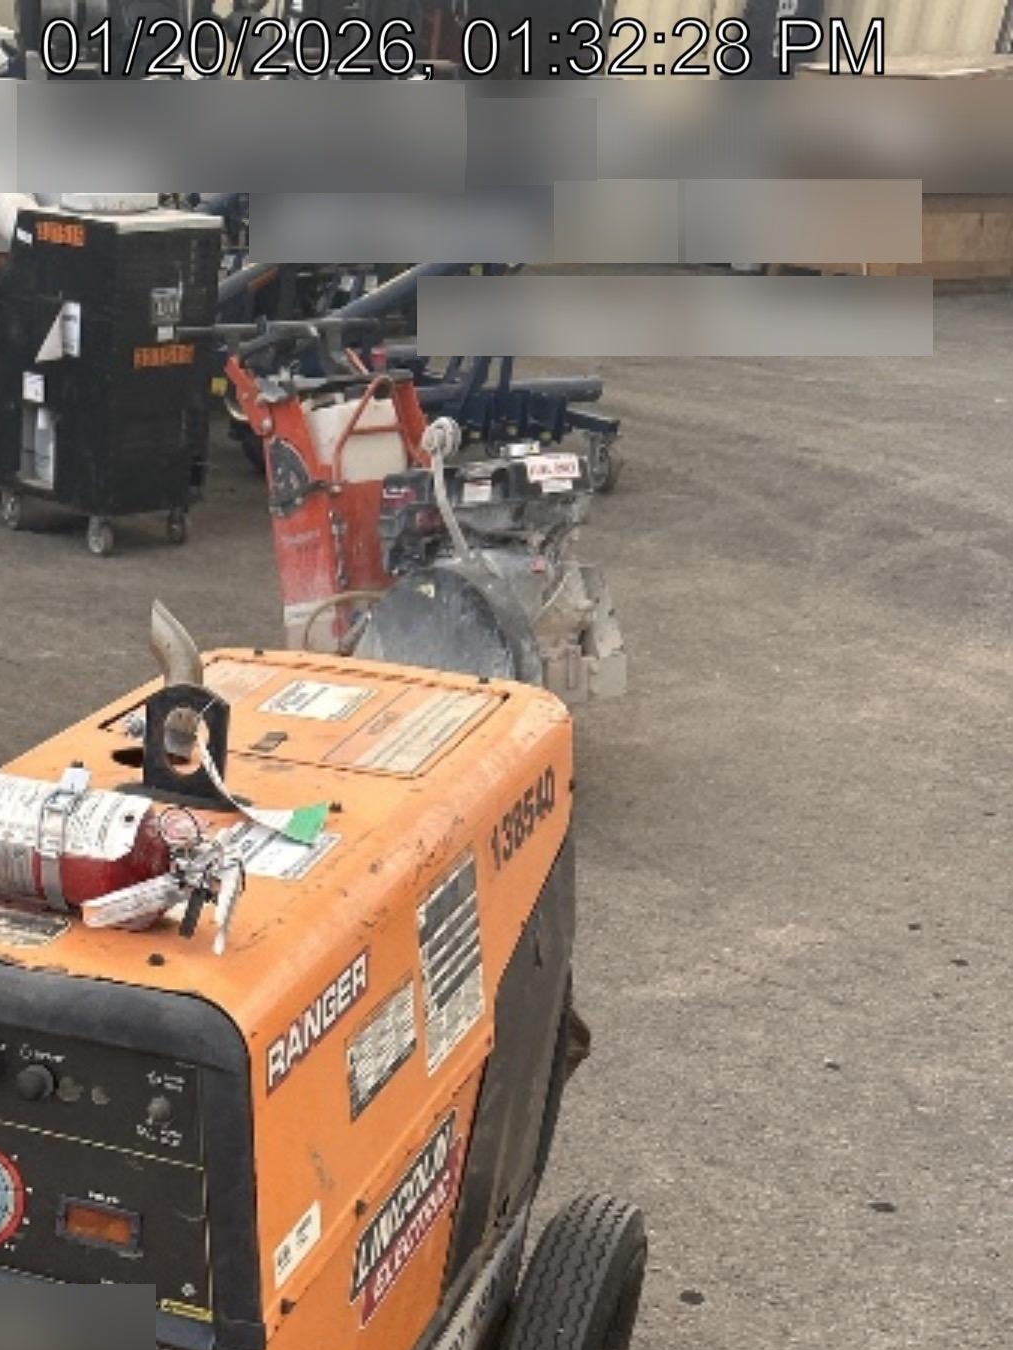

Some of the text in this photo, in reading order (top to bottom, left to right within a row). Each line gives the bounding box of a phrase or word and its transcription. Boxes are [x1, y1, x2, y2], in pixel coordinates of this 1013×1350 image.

[490, 765, 556, 871] 138540
[267, 950, 367, 1089] RANGER
[354, 1120, 451, 1290] LINCOLN
